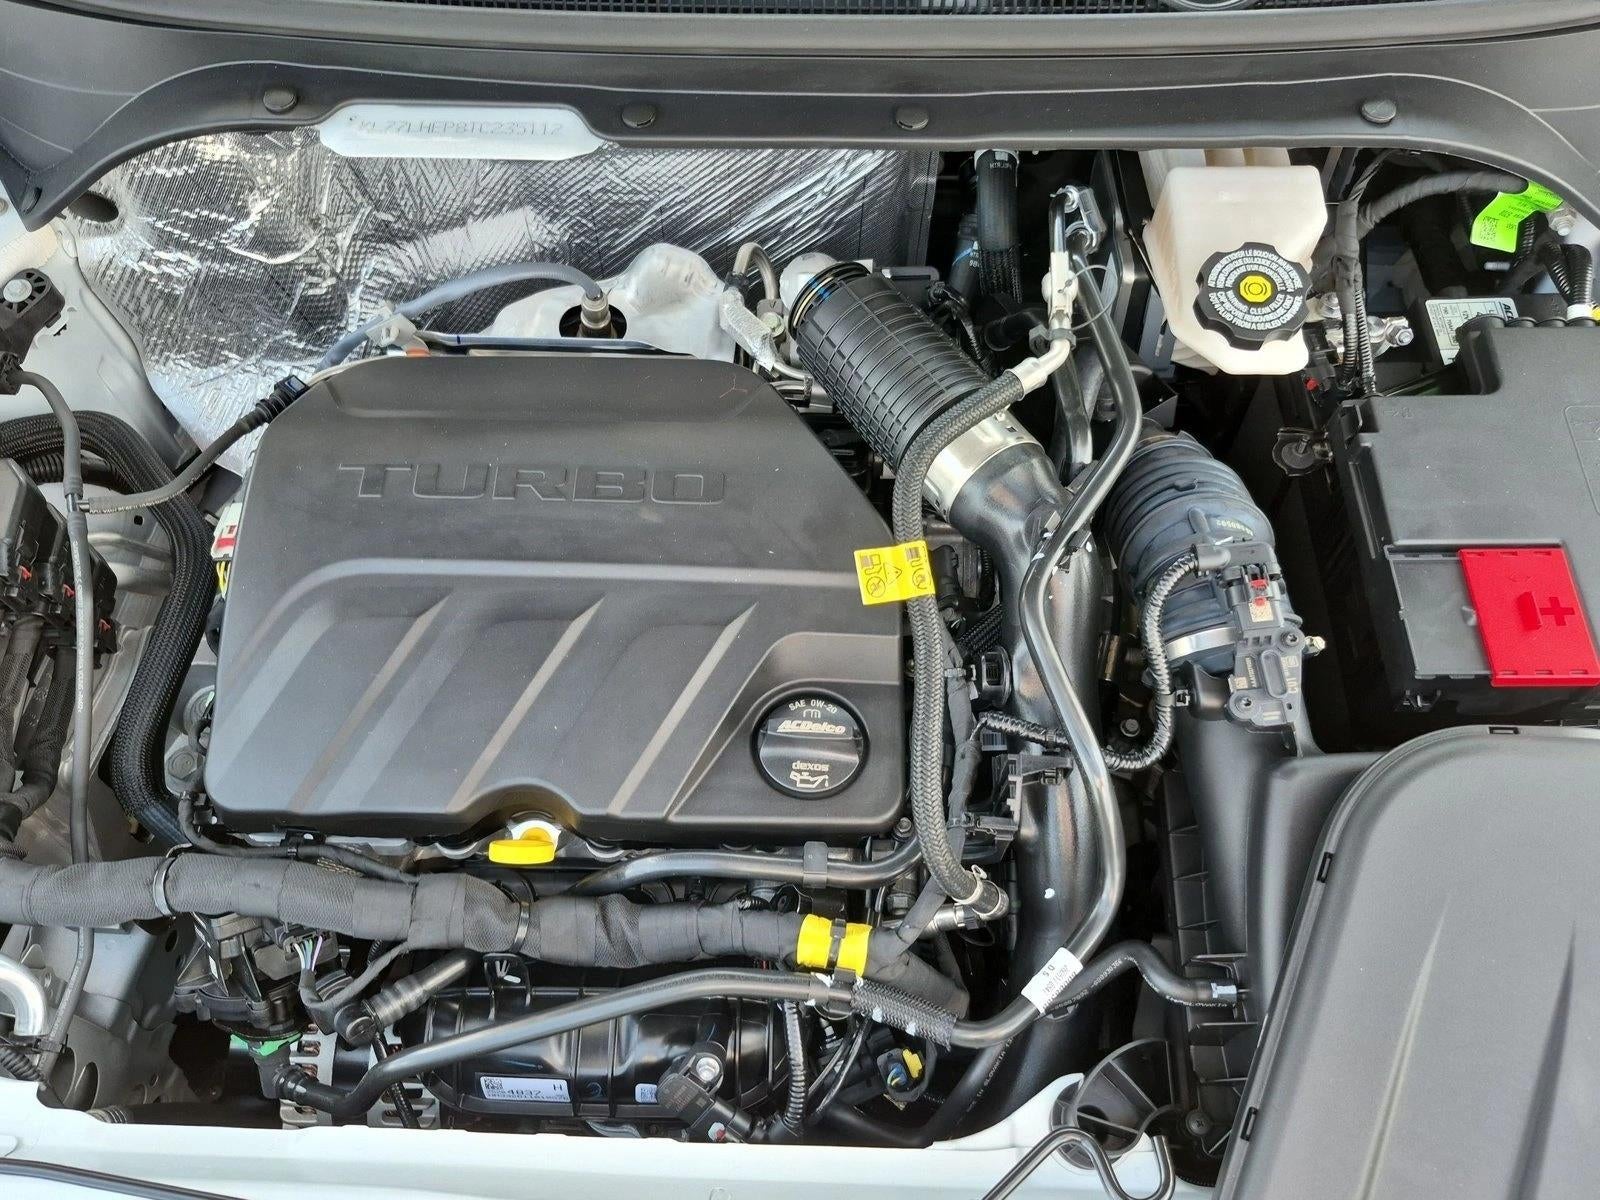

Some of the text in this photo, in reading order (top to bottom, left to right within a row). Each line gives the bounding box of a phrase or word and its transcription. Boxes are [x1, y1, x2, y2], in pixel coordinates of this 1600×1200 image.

[1245, 249, 1253, 257] LE
[1249, 306, 1271, 315] CLEAN
[1232, 317, 1253, 329] FROM
[1257, 319, 1281, 330] SEALED
[338, 463, 726, 504] TURBO
[788, 699, 838, 714] SAE 0W-20
[776, 720, 846, 735] ACDelco
[791, 760, 830, 772] dexos
